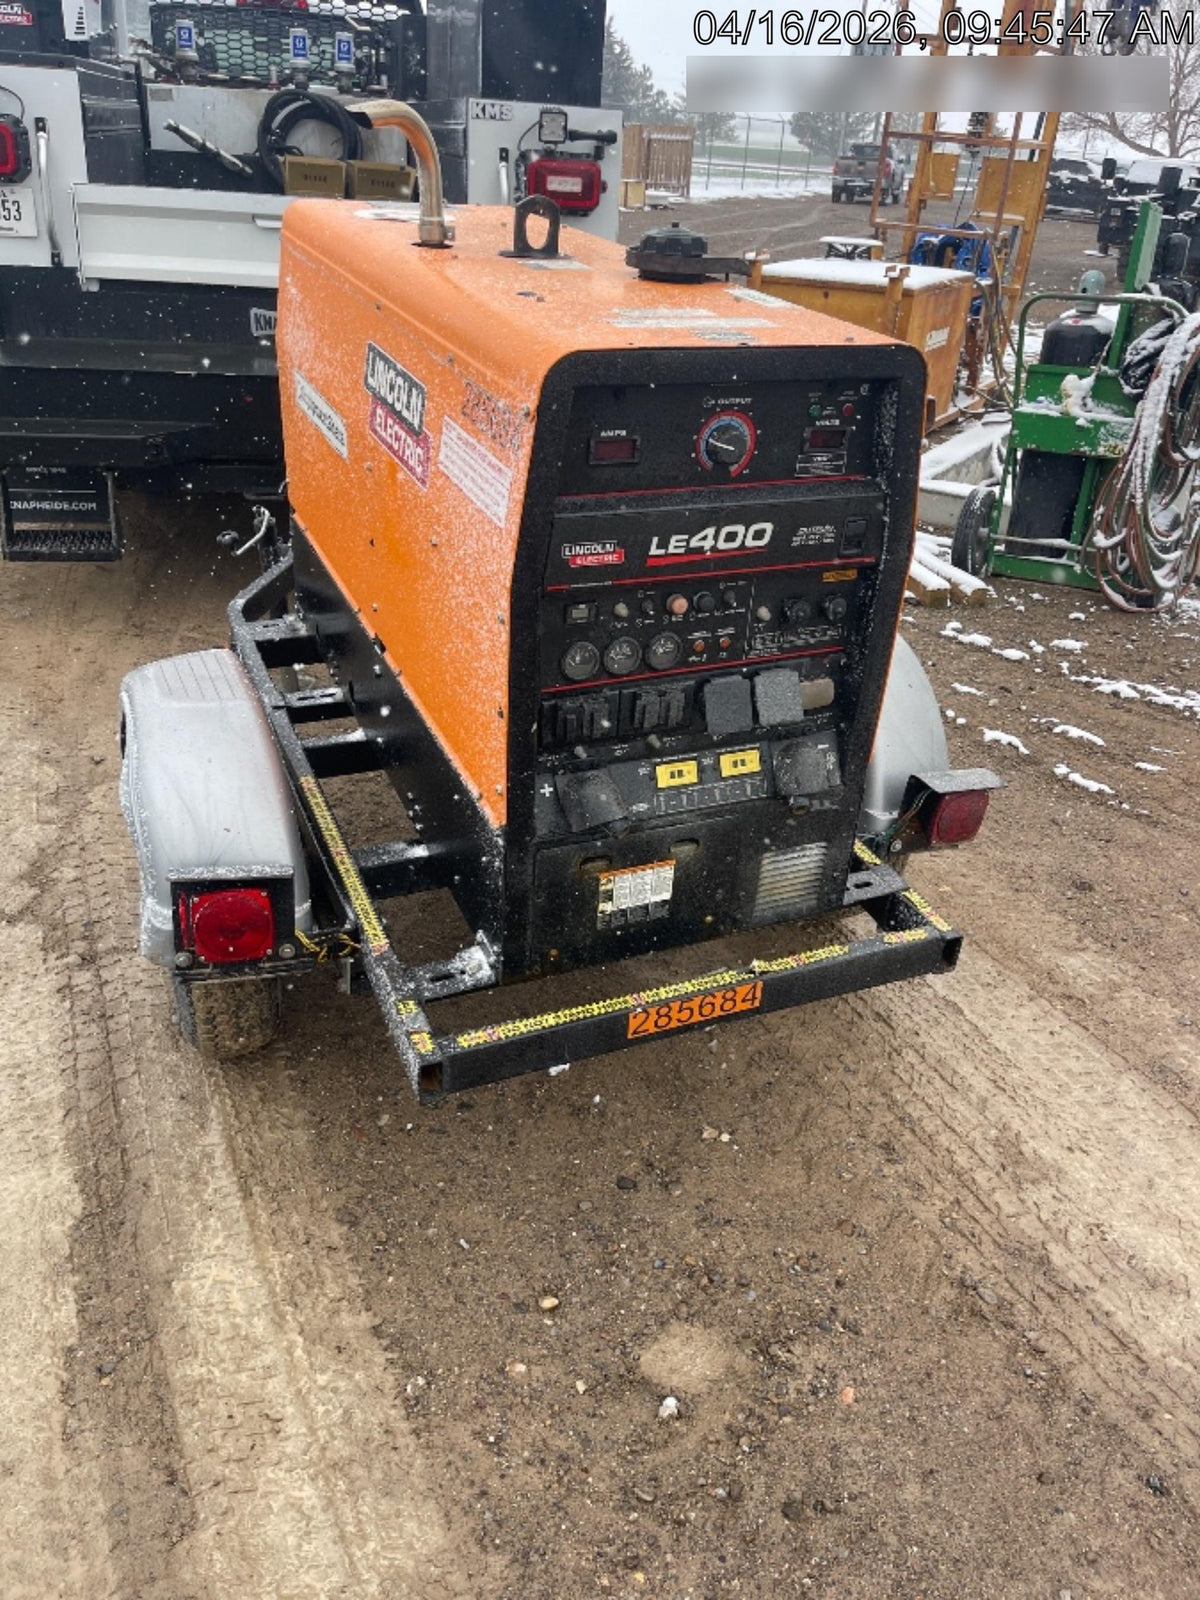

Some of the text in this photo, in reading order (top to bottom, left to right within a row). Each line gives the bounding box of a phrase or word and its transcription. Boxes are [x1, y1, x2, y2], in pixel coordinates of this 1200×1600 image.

[471, 102, 513, 121] KMS
[367, 351, 423, 433] LINCOLN
[375, 406, 424, 475] ELECTRIC
[564, 543, 614, 556] LINCOLN
[648, 522, 774, 557] LE400
[575, 553, 620, 566] ELECTRIC
[631, 981, 760, 1037] 285684
